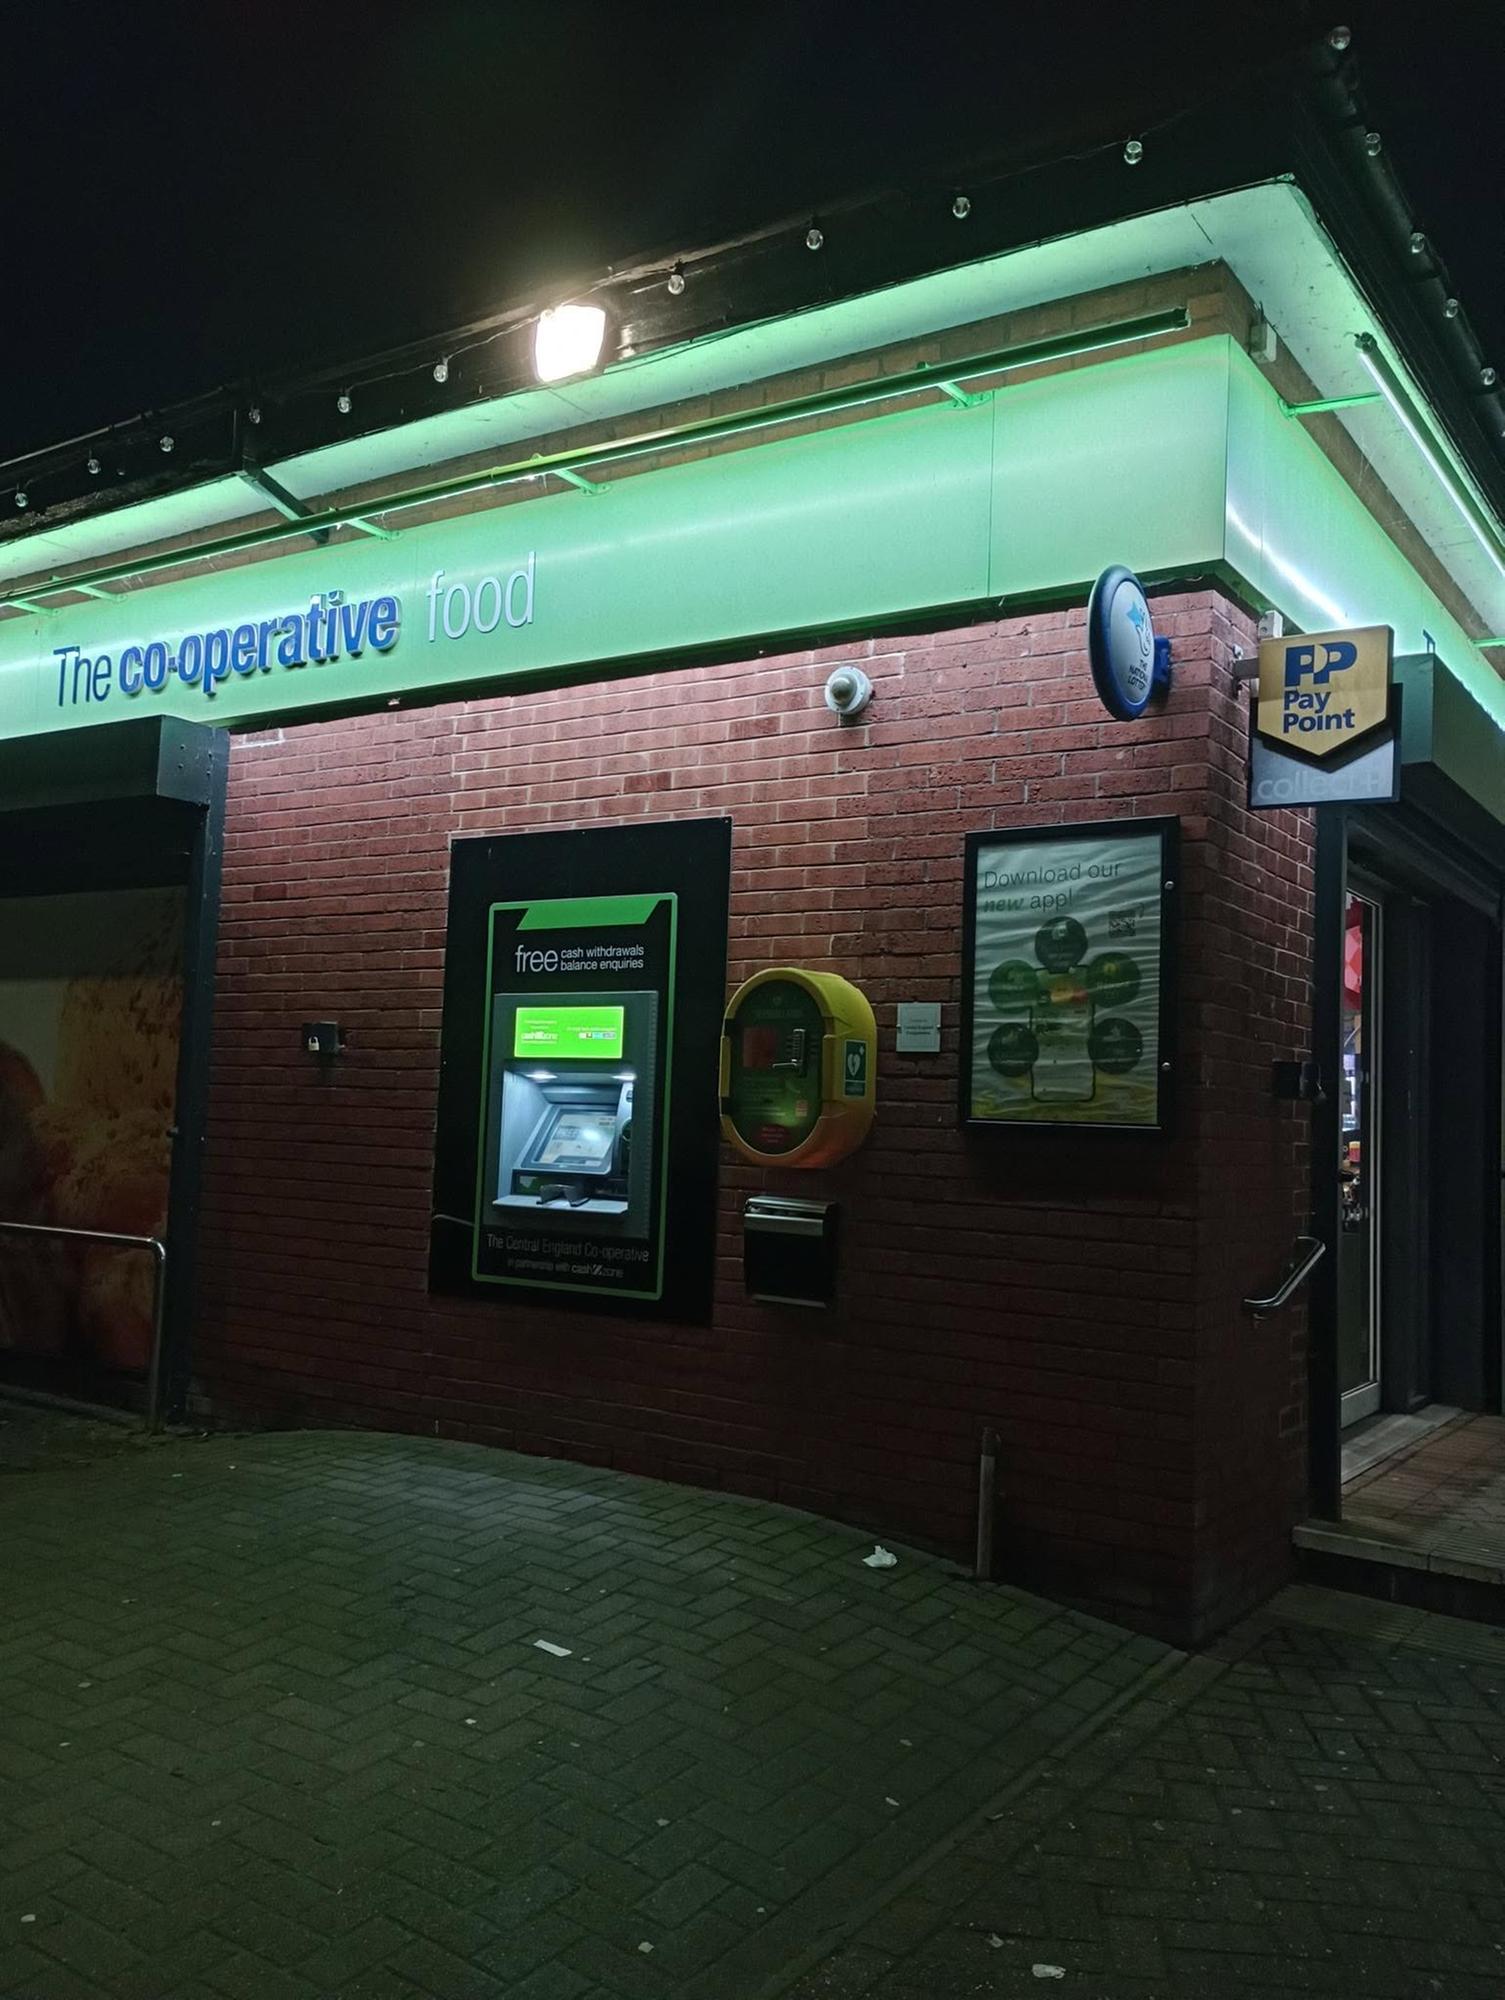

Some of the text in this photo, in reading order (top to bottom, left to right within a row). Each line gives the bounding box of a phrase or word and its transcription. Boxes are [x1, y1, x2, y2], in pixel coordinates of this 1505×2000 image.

[53, 551, 537, 707] The co-operative food
[1284, 690, 1331, 714] Pay
[1283, 708, 1355, 733] Point
[984, 862, 1120, 889] Download our
[983, 887, 1072, 912] new app!
[515, 944, 559, 973] free
[560, 944, 645, 959] cash withdrawals
[560, 957, 644, 971] balance enquiries
[486, 1232, 650, 1263] The Central England Co-operative
